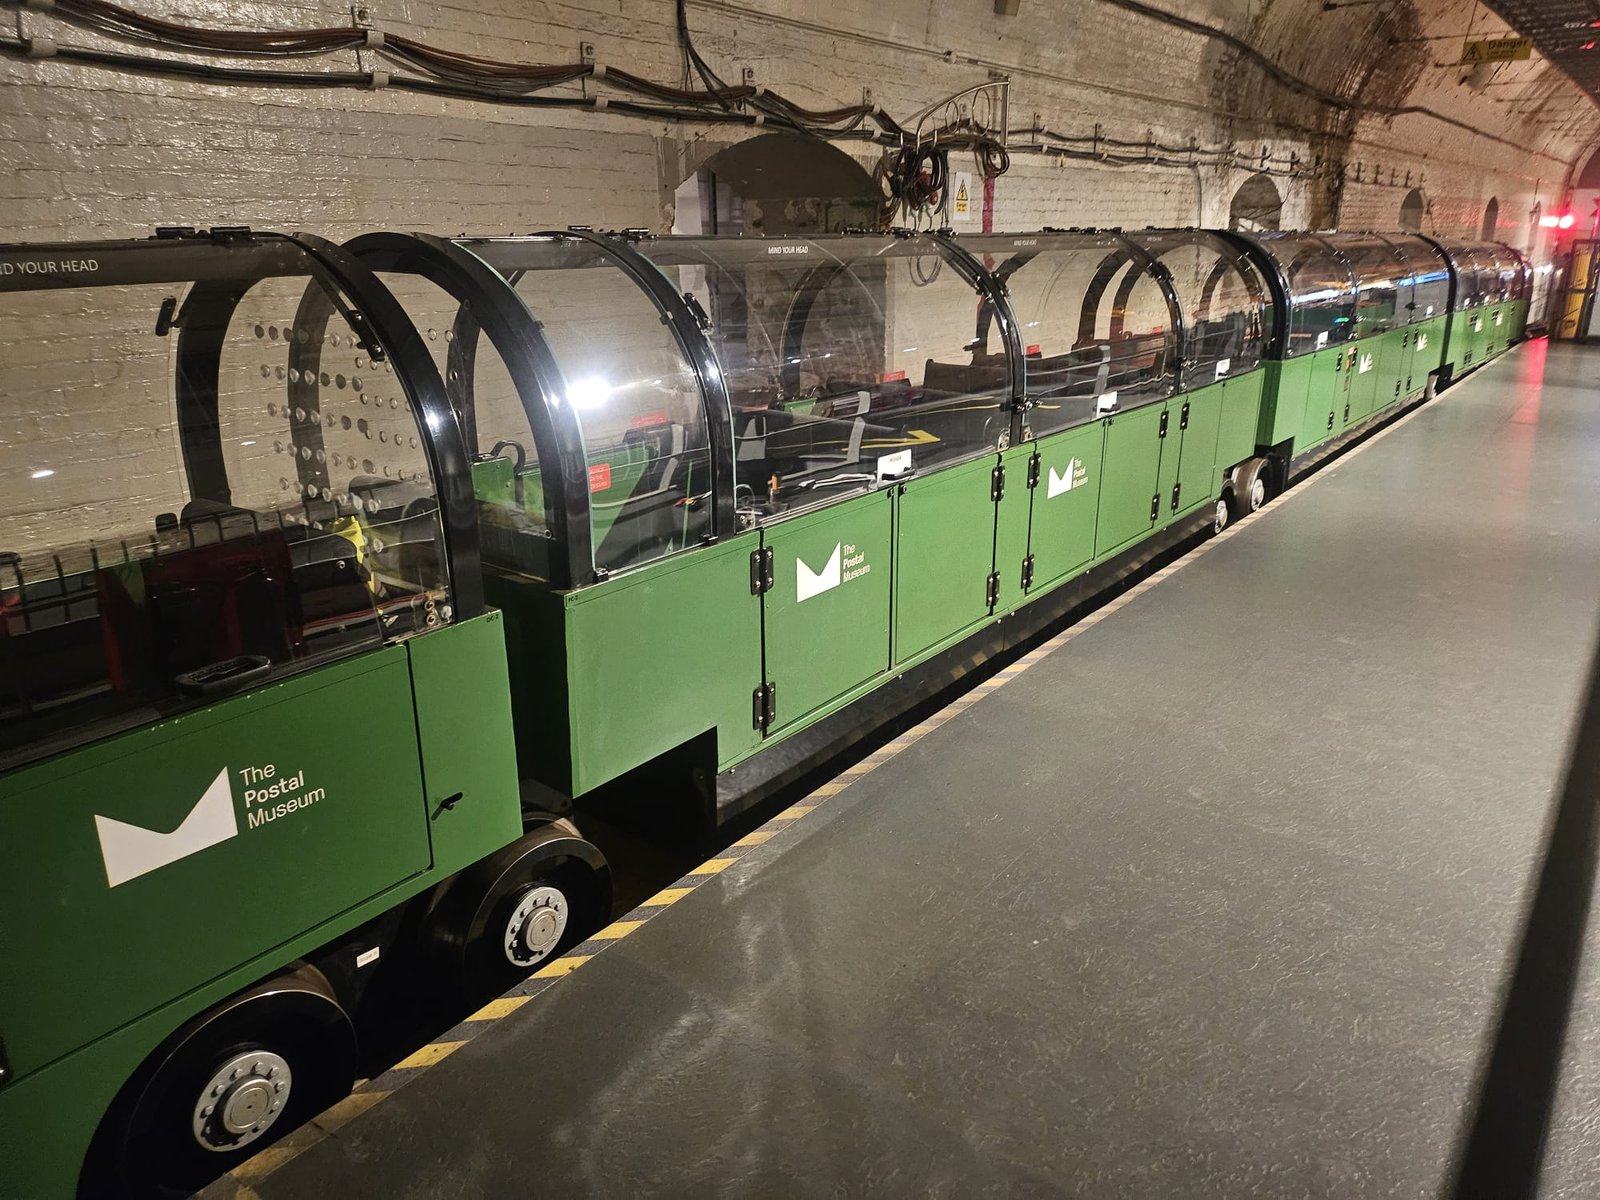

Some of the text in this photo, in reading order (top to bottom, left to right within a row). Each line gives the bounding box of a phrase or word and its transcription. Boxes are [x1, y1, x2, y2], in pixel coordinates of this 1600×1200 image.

[1488, 39, 1527, 50] Danger
[768, 246, 809, 254] MIND YOUR HEAD
[16, 261, 58, 274] YOUR
[60, 259, 99, 273] HEAD
[842, 544, 856, 556] The
[843, 551, 865, 570] Postal
[843, 564, 871, 583] Museum
[239, 764, 276, 785] The
[244, 770, 305, 808] Postal
[247, 787, 326, 829] Museum
